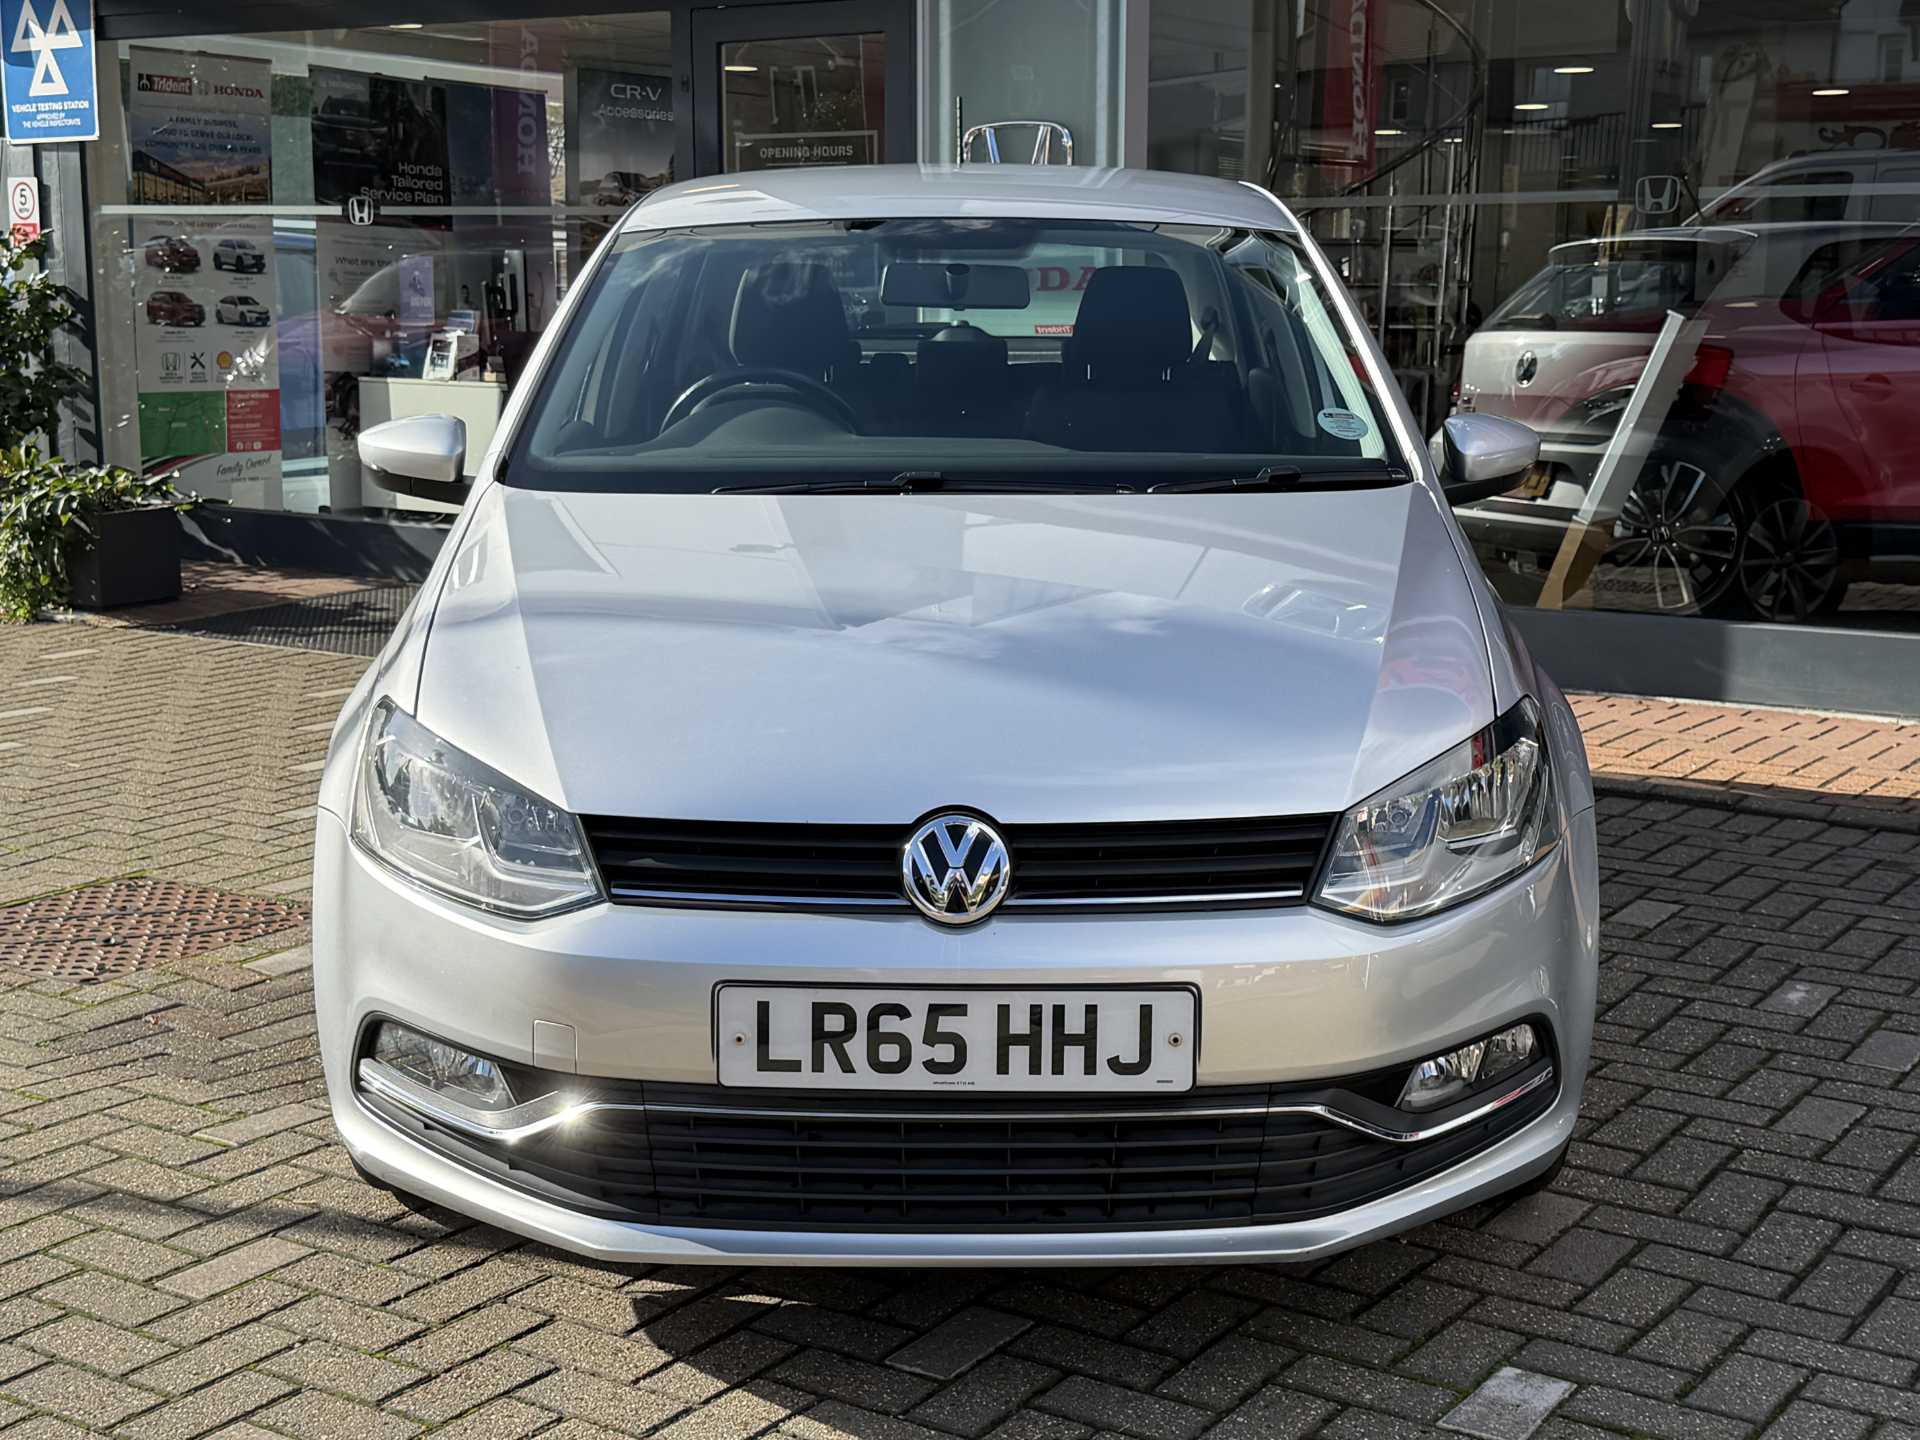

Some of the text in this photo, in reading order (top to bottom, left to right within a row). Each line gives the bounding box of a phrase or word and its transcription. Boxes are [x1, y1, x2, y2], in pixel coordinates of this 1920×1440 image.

[153, 77, 264, 98] Trident HONDA
[610, 84, 662, 100] CR-V
[599, 104, 674, 121] Accessories
[760, 145, 853, 159] OPENING HOURS
[398, 162, 443, 177] Honda
[391, 175, 443, 191] Tailored
[20, 188, 27, 206] 5
[360, 186, 444, 204] Service Plan
[335, 256, 359, 266] What
[756, 1000, 1153, 1077] LR65 HHJ
